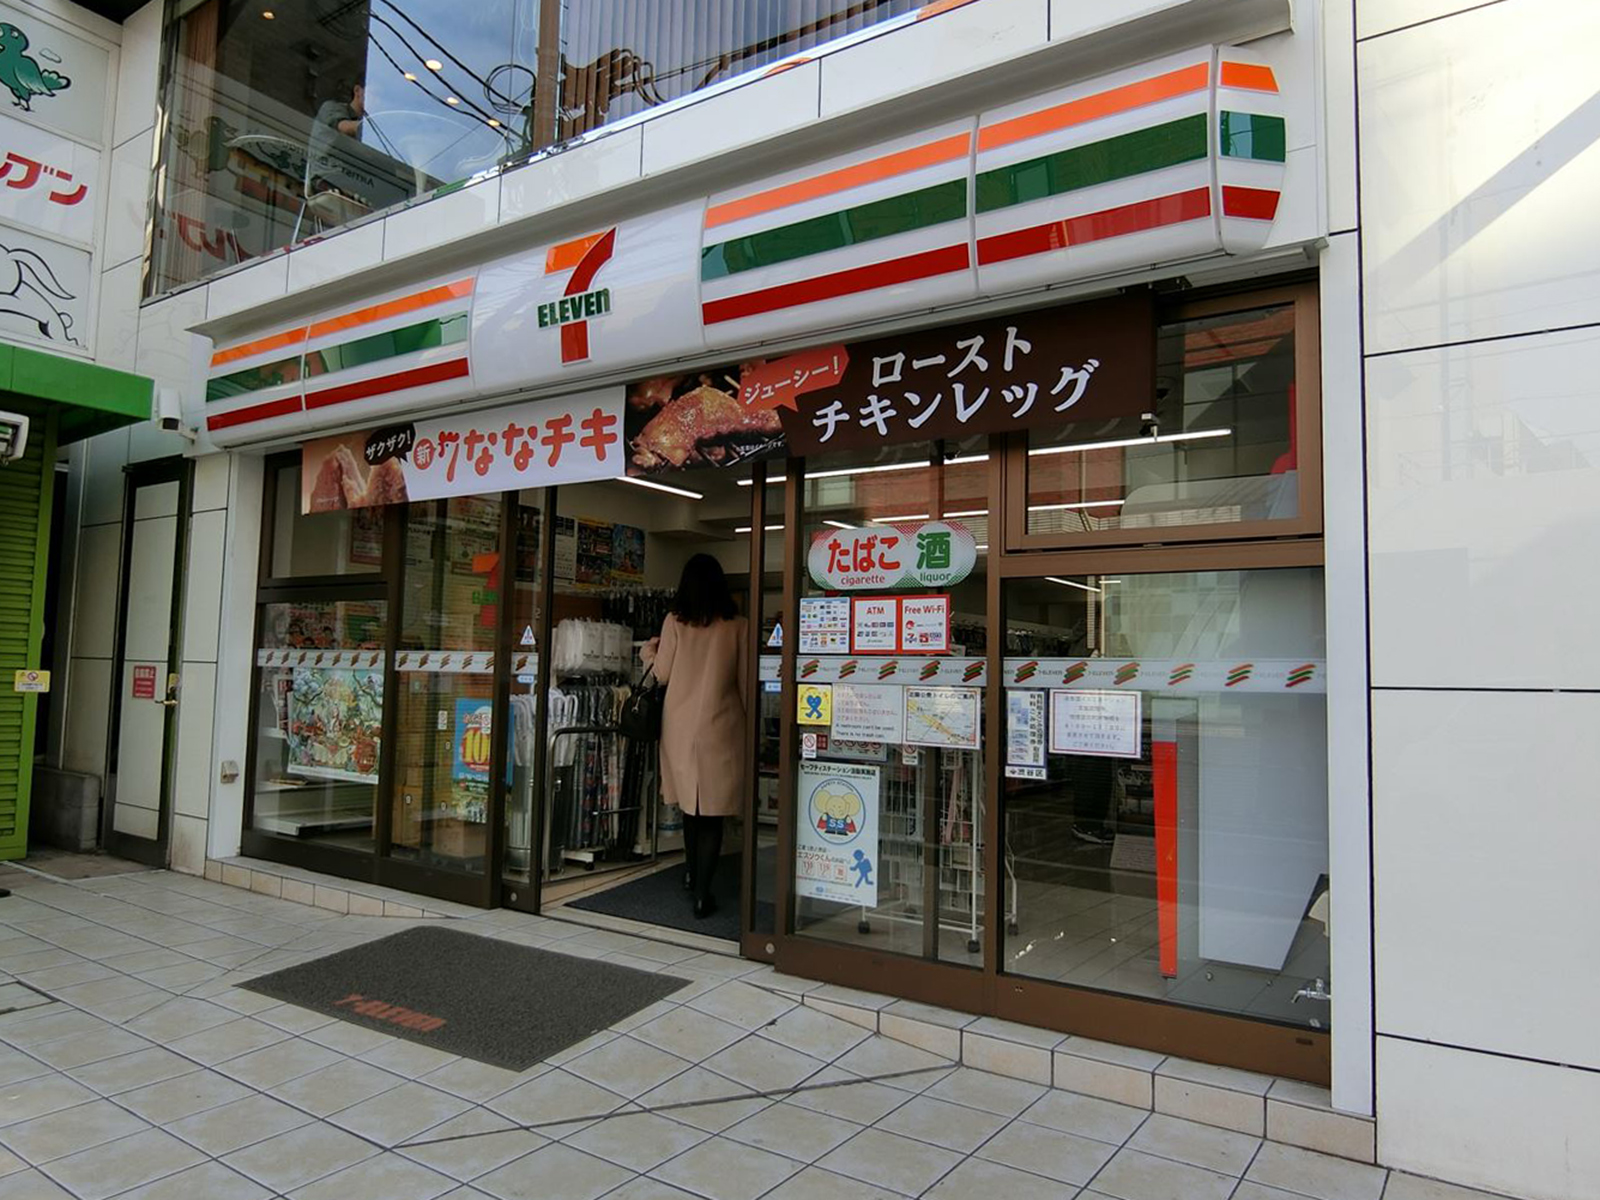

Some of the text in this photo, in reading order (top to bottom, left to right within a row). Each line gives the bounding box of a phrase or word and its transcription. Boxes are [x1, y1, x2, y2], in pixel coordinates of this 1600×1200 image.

[545, 226, 617, 365] 7
[871, 325, 1033, 387] ロースト
[811, 358, 1101, 443] チキンレッグ
[414, 442, 434, 469] 新
[827, 532, 952, 573] たばこ 酒
[841, 572, 952, 587] cigarette liquor
[866, 606, 885, 615] ATM
[904, 604, 945, 615] Free Wi-Fi
[829, 819, 845, 828] SS
